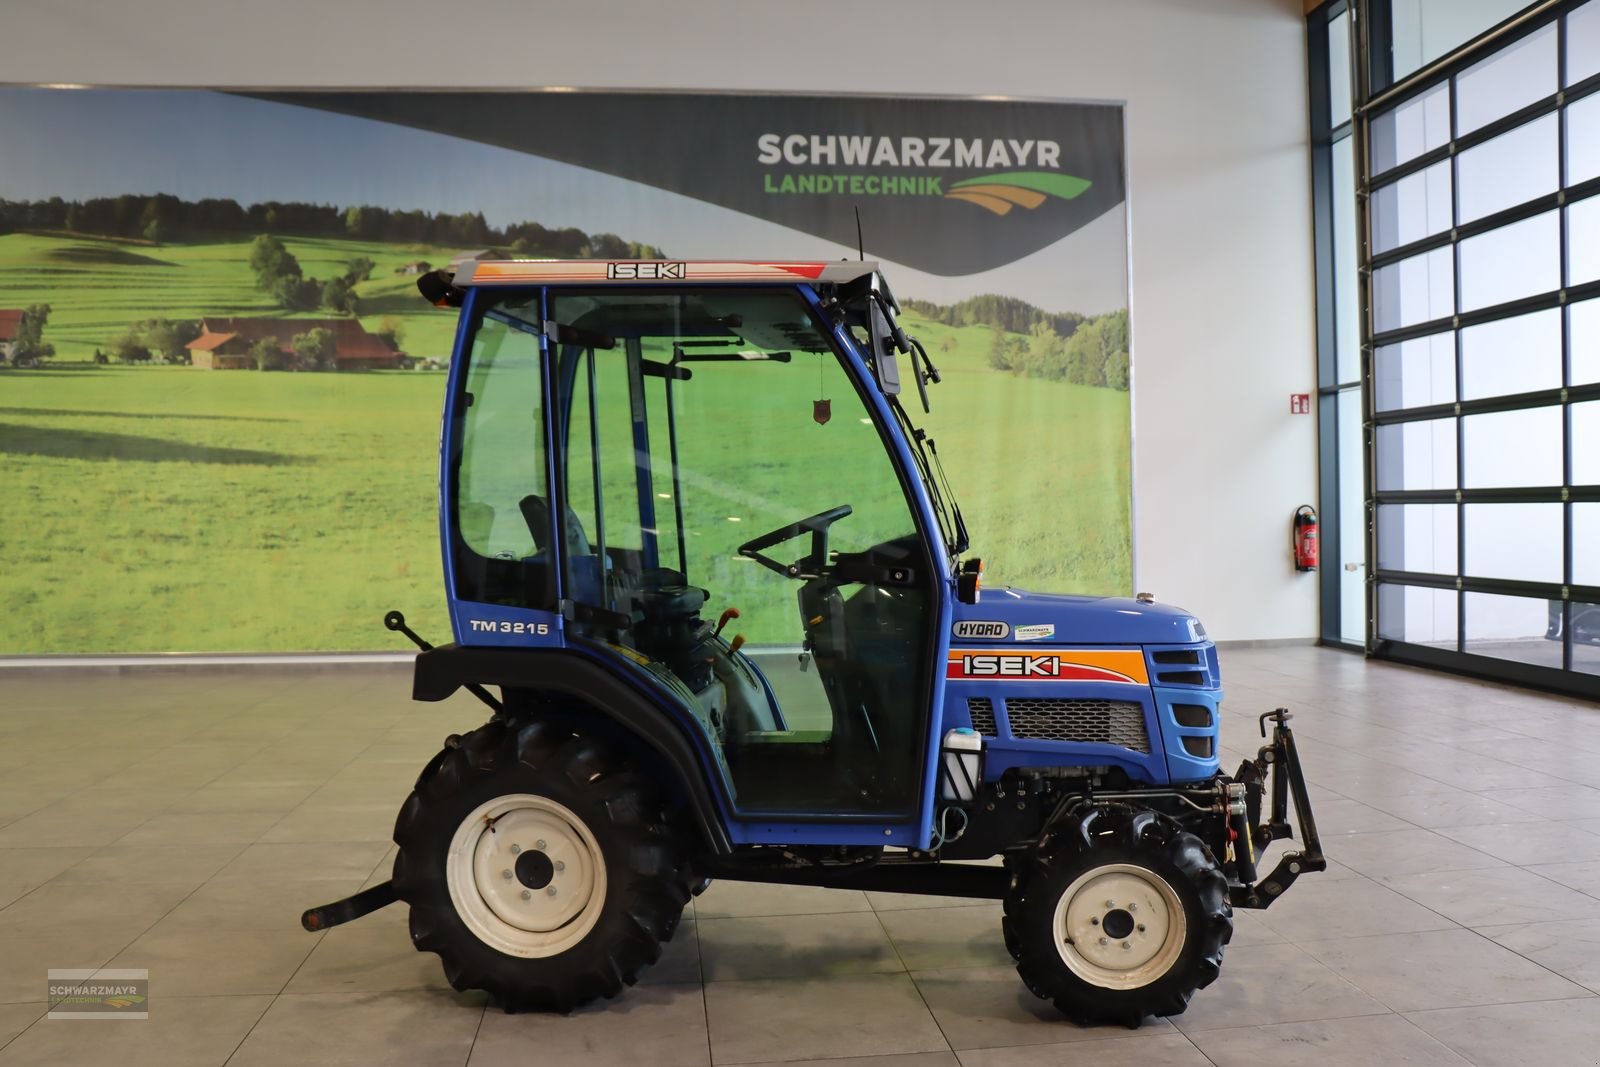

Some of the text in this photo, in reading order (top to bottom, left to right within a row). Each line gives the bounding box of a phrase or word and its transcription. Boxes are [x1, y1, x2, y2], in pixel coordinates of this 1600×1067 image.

[757, 134, 1061, 168] SCHWARZMAYR
[764, 174, 943, 195] LANDTECHNIK
[607, 262, 686, 279] ISEKI
[470, 620, 548, 635] TM 3215
[958, 623, 1003, 635] HYDRO
[963, 655, 1060, 676] ISEKI
